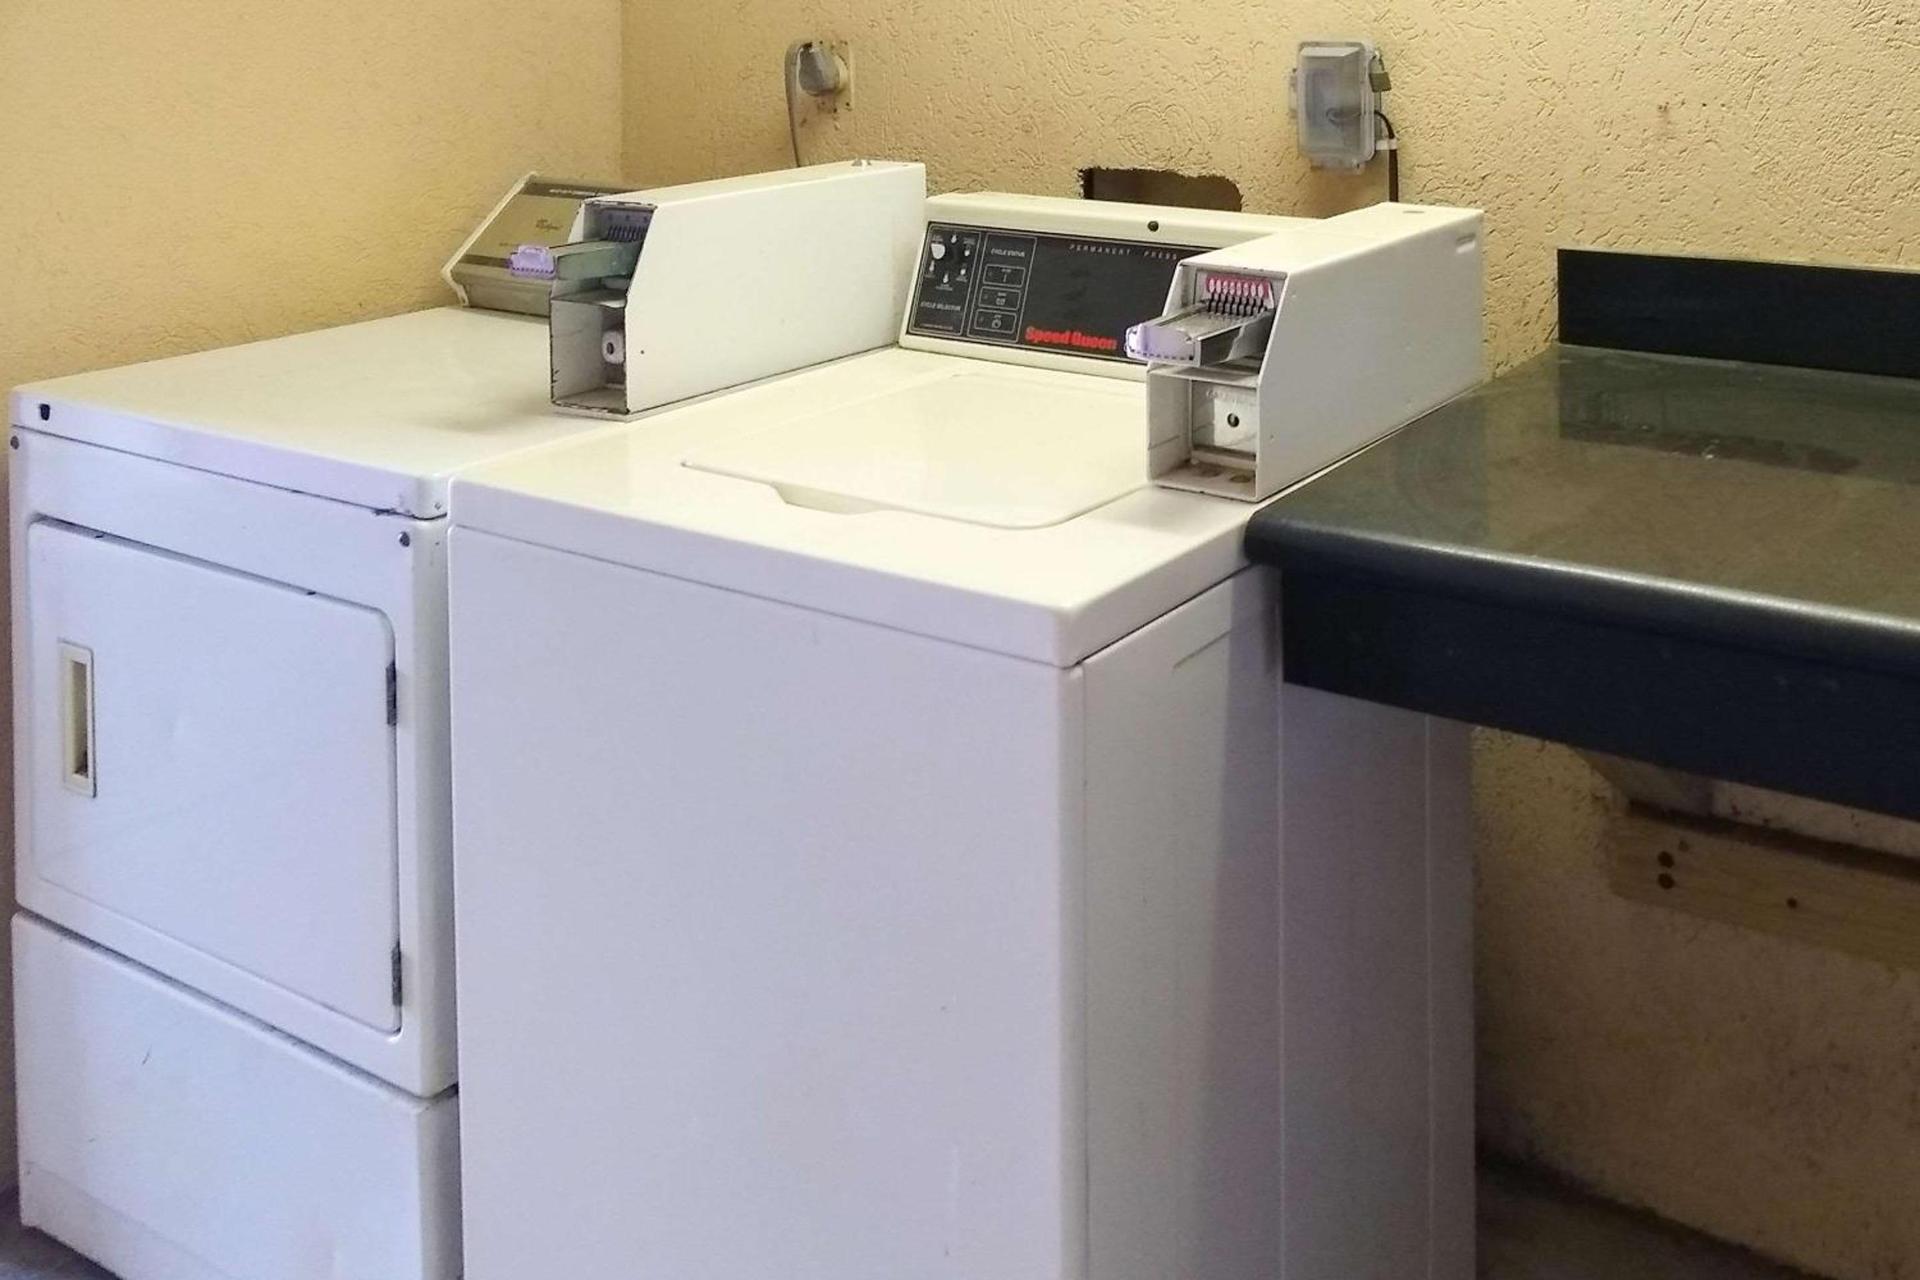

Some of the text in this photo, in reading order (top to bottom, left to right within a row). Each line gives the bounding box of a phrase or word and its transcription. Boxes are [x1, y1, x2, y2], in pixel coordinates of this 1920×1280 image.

[1069, 244, 1177, 260] PERMANENT PRESS
[1025, 326, 1070, 344] Speed
